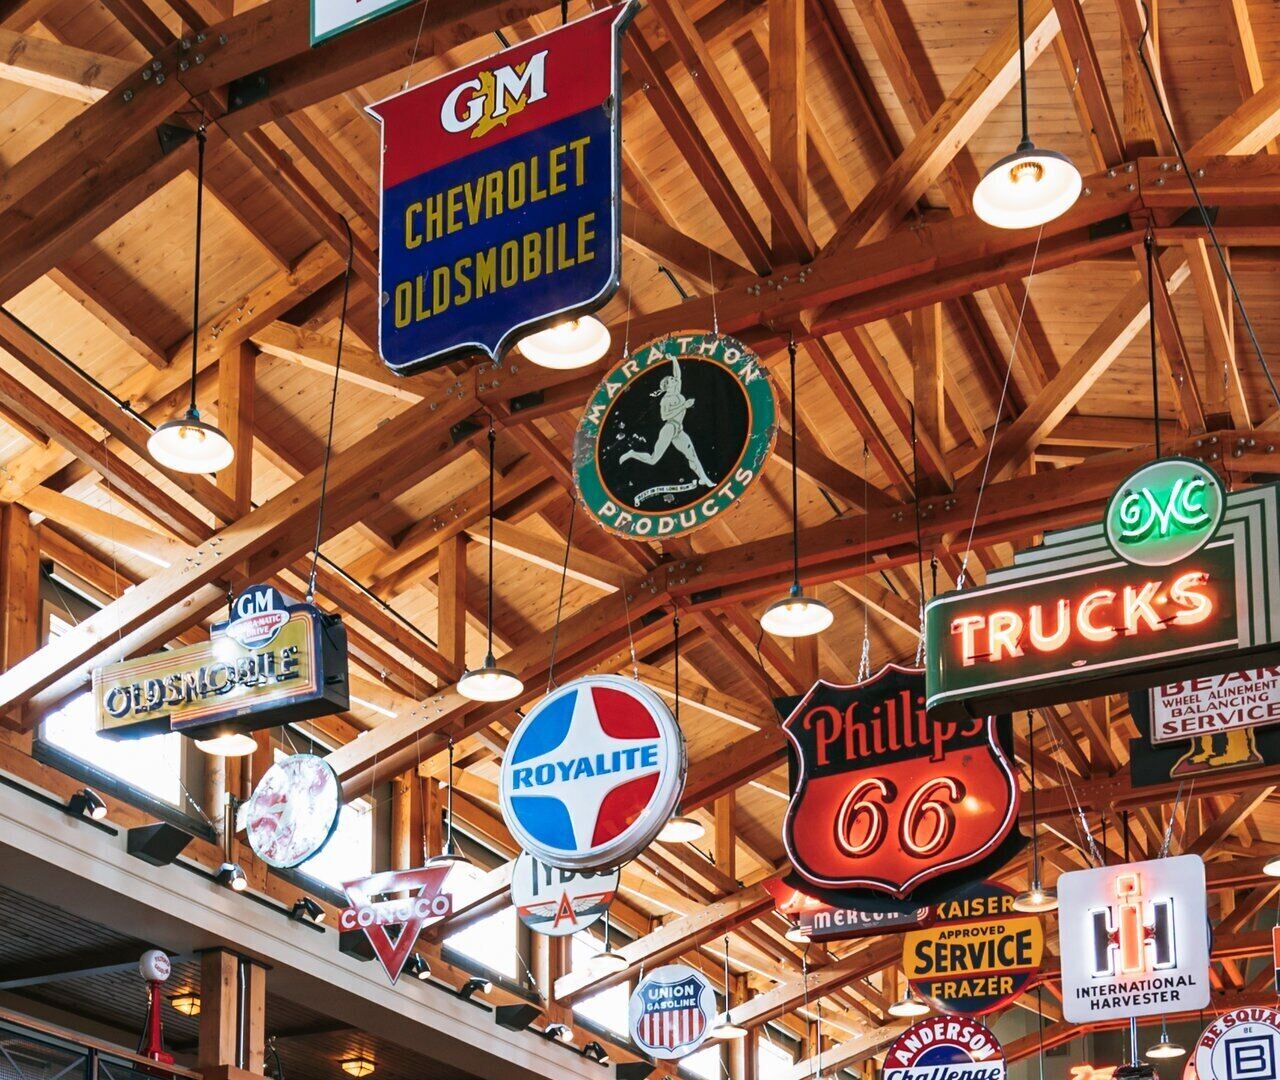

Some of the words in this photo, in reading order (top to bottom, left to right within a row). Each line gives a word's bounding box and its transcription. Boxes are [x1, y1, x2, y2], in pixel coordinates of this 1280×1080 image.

[440, 50, 547, 133] GM
[405, 137, 591, 250] CHEVROLET
[394, 212, 595, 329] OLDSMOBILE
[586, 335, 760, 424] MARATHON
[598, 465, 756, 536] PRODUCTS
[1118, 477, 1213, 545] GMC
[237, 588, 273, 617] GM
[951, 571, 1214, 667] TRUCKS
[104, 646, 299, 718] OLDSMOBILE
[1161, 665, 1280, 698] BEAR
[1162, 694, 1202, 709] WHEEL
[1208, 679, 1278, 701] ALINEMENT
[1171, 692, 1269, 718] BALANCING
[511, 743, 659, 789] ROYALITE
[833, 776, 967, 859] 66
[341, 895, 450, 929] CONOCO
[936, 896, 1015, 920] KAISER
[939, 925, 1006, 940] APPROVED
[914, 928, 1033, 975] SERVICE
[648, 984, 695, 1000] UNION
[931, 976, 1014, 1000] FRAZER
[1075, 974, 1197, 999] INTERNATIONAL
[1090, 990, 1181, 1011] HARVESTER
[646, 997, 697, 1012] GASOLINE
[896, 1022, 996, 1065] ANDERSON
[1200, 1025, 1223, 1050] BE
[1243, 1026, 1253, 1034] BE
